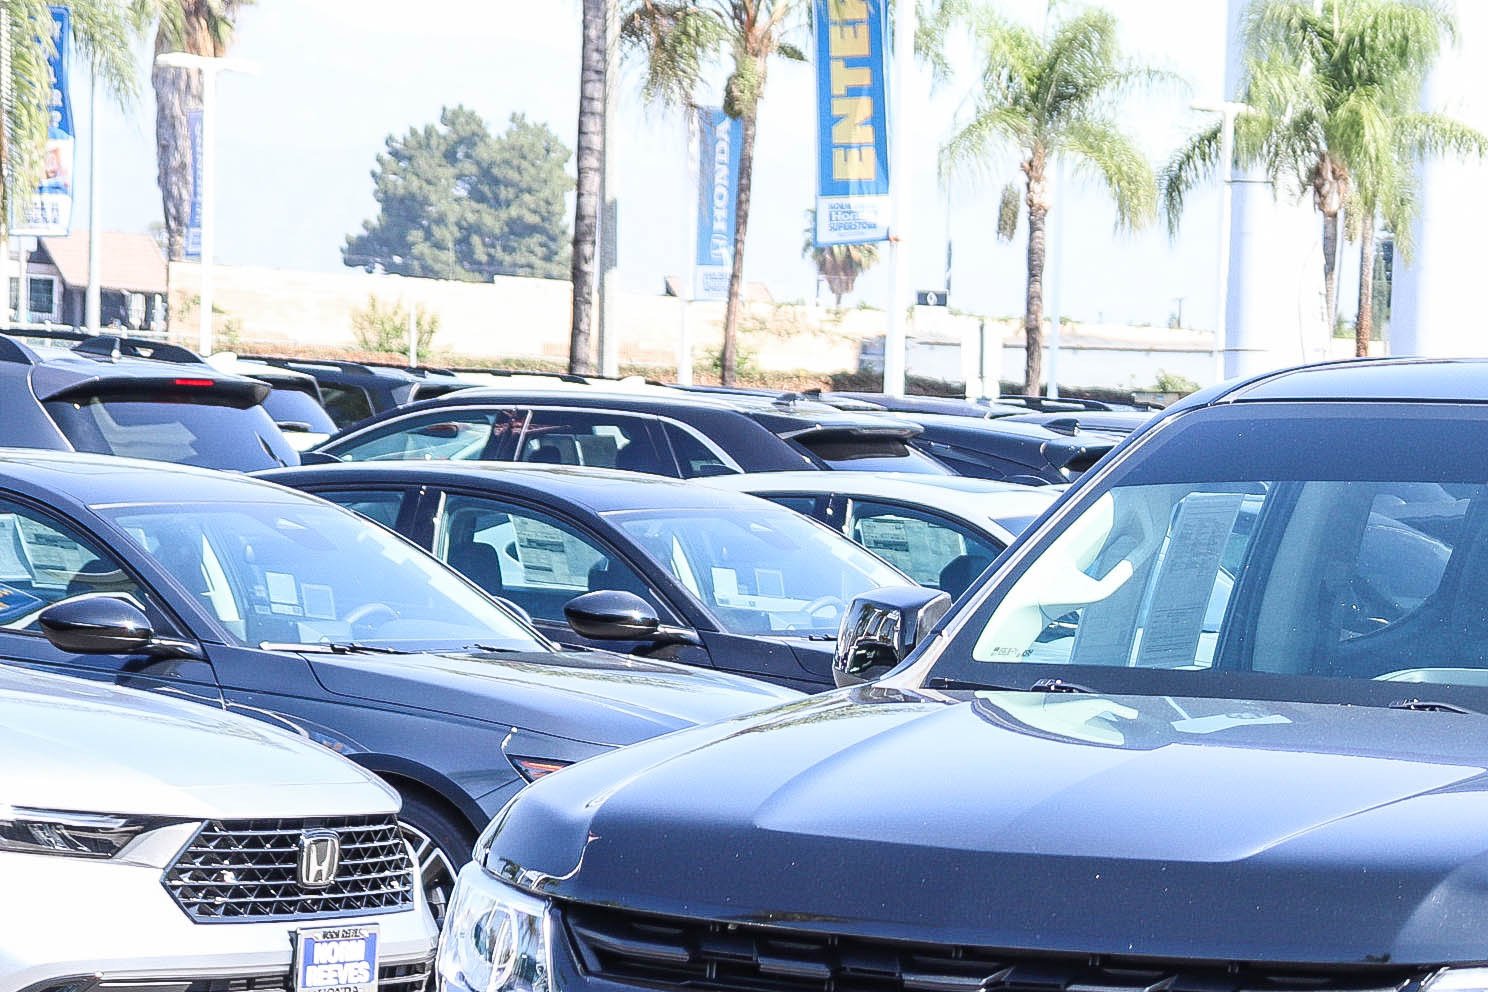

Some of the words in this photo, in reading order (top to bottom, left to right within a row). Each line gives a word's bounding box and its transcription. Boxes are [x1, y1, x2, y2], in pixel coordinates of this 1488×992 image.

[712, 117, 733, 234] HONDA
[313, 940, 366, 964] NORM
[305, 960, 371, 987] REEVES
